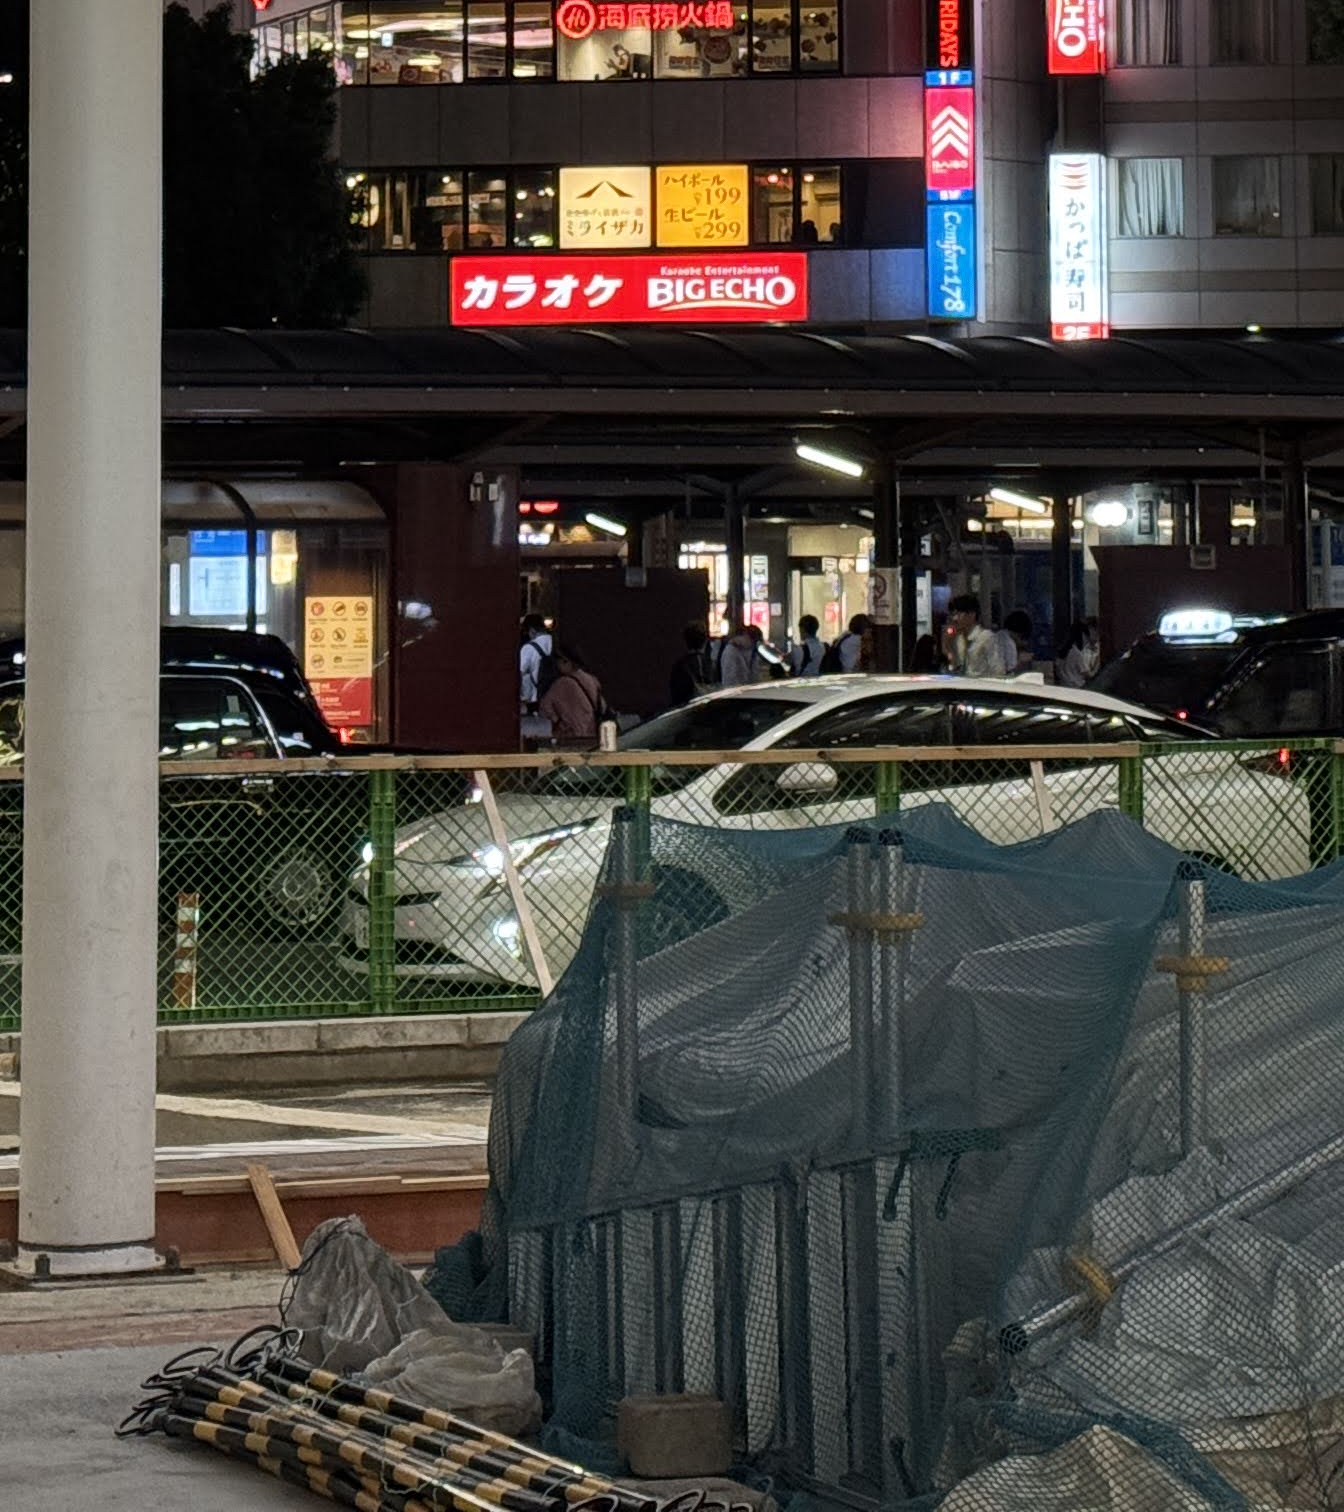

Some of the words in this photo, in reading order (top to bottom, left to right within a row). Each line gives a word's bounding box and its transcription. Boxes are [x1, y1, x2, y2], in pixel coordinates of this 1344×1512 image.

[938, 71, 960, 85] 1F
[664, 172, 725, 188] ハイボール
[664, 208, 725, 224] 生ビール
[567, 219, 644, 238] ミライザカ
[1065, 197, 1088, 313] かっぱ寿司
[460, 274, 624, 310] カラオケ
[647, 277, 707, 309] BIG
[709, 275, 797, 307] ECHO
